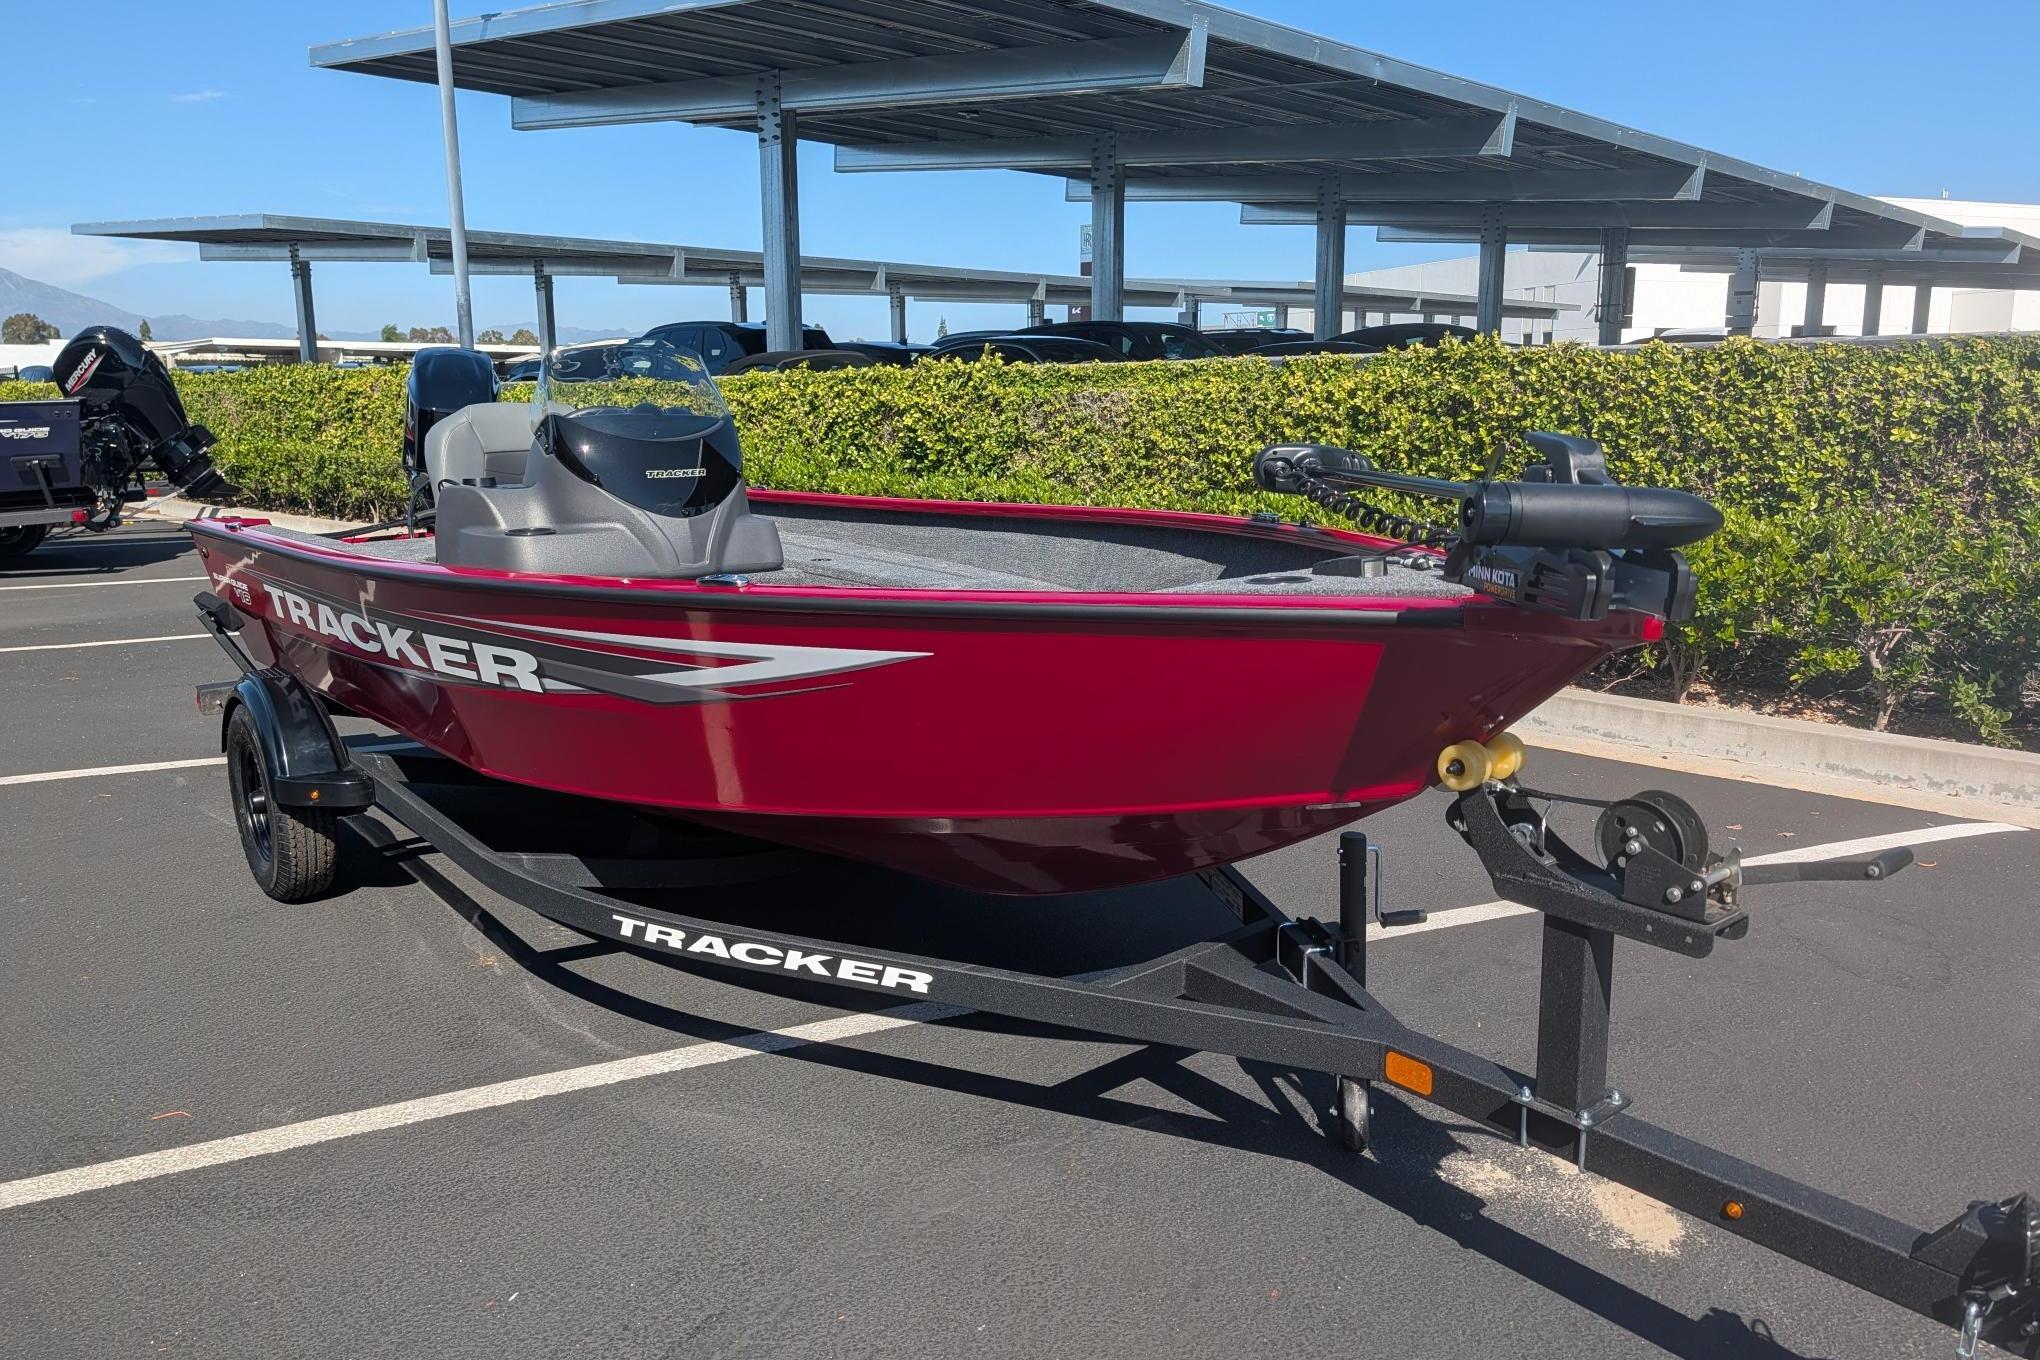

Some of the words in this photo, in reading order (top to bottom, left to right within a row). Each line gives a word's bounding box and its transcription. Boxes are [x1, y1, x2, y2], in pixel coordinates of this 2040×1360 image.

[65, 348, 96, 392] MERCURY
[646, 468, 706, 478] TRACKER
[1468, 564, 1491, 581] MINN
[1492, 568, 1515, 588] KOTA
[263, 584, 544, 693] TRACKER
[612, 914, 934, 994] TRACKER
